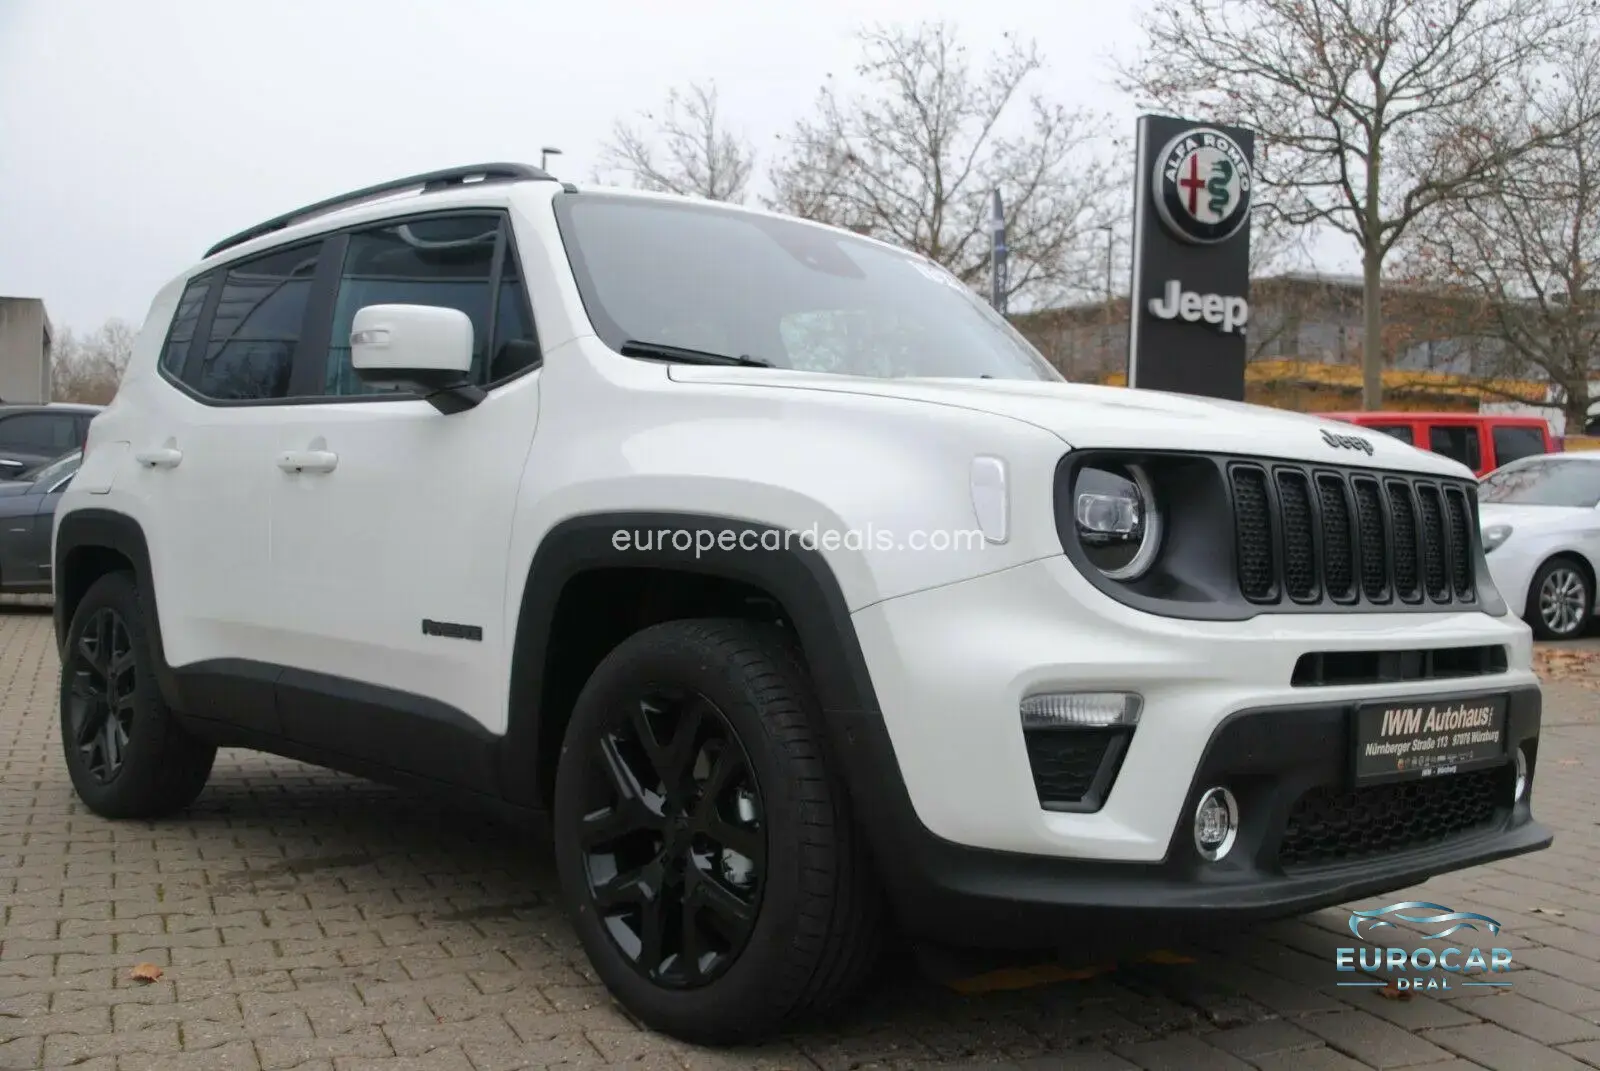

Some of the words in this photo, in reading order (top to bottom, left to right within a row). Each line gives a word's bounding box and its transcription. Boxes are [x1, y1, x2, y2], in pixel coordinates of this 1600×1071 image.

[1165, 137, 1199, 183] ALFA
[1204, 133, 1250, 192] ROMEO
[1148, 279, 1249, 333] Jeep
[1319, 428, 1374, 457] Jeep
[1381, 707, 1423, 737] IWM
[1423, 704, 1489, 732] Autohaus
[1365, 742, 1411, 756] Nürnberger
[1412, 737, 1435, 751] Straße
[1437, 735, 1449, 748] 113
